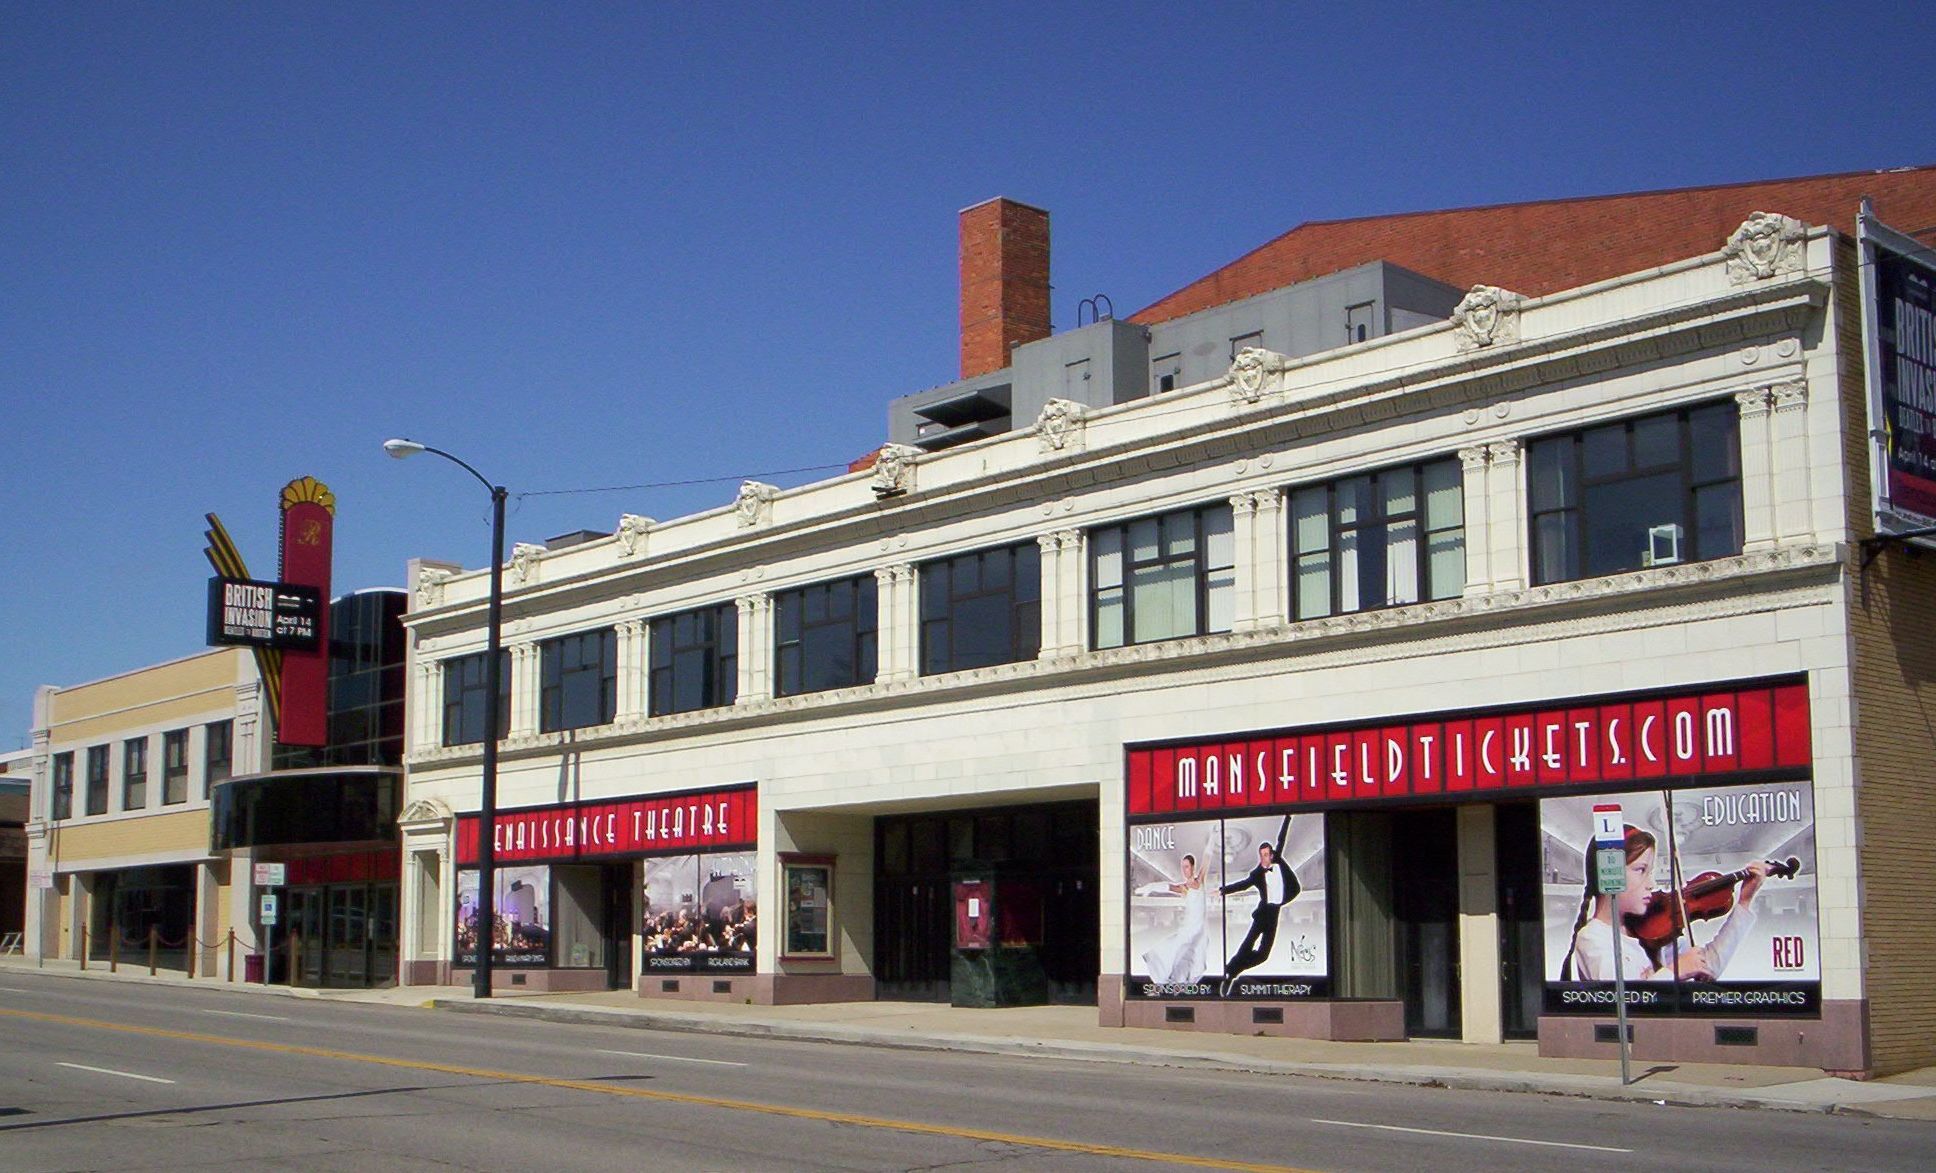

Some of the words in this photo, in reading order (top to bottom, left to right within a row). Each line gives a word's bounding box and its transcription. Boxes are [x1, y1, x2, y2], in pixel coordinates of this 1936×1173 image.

[225, 583, 273, 610] BRITISH
[225, 606, 273, 628] INVASION
[300, 616, 312, 626] 14
[289, 627, 295, 635] 7
[297, 627, 312, 637] PM
[1701, 790, 1801, 825] EDUCATION
[493, 813, 617, 852] ENAISSANCE
[634, 802, 728, 841] THEATRE
[1603, 818, 1616, 833] L
[1136, 826, 1175, 850] DANCE
[1773, 937, 1805, 968] RED
[1143, 984, 1198, 997] SPONSORED
[1200, 984, 1211, 995] BY
[1240, 984, 1272, 996] SUMMIT
[1273, 984, 1312, 996] THERAPY
[1562, 991, 1640, 1004] SPONSOED
[1642, 992, 1658, 1004] BY
[1692, 991, 1743, 1005] PREMIER
[1745, 991, 1806, 1005] GRAPHICS
